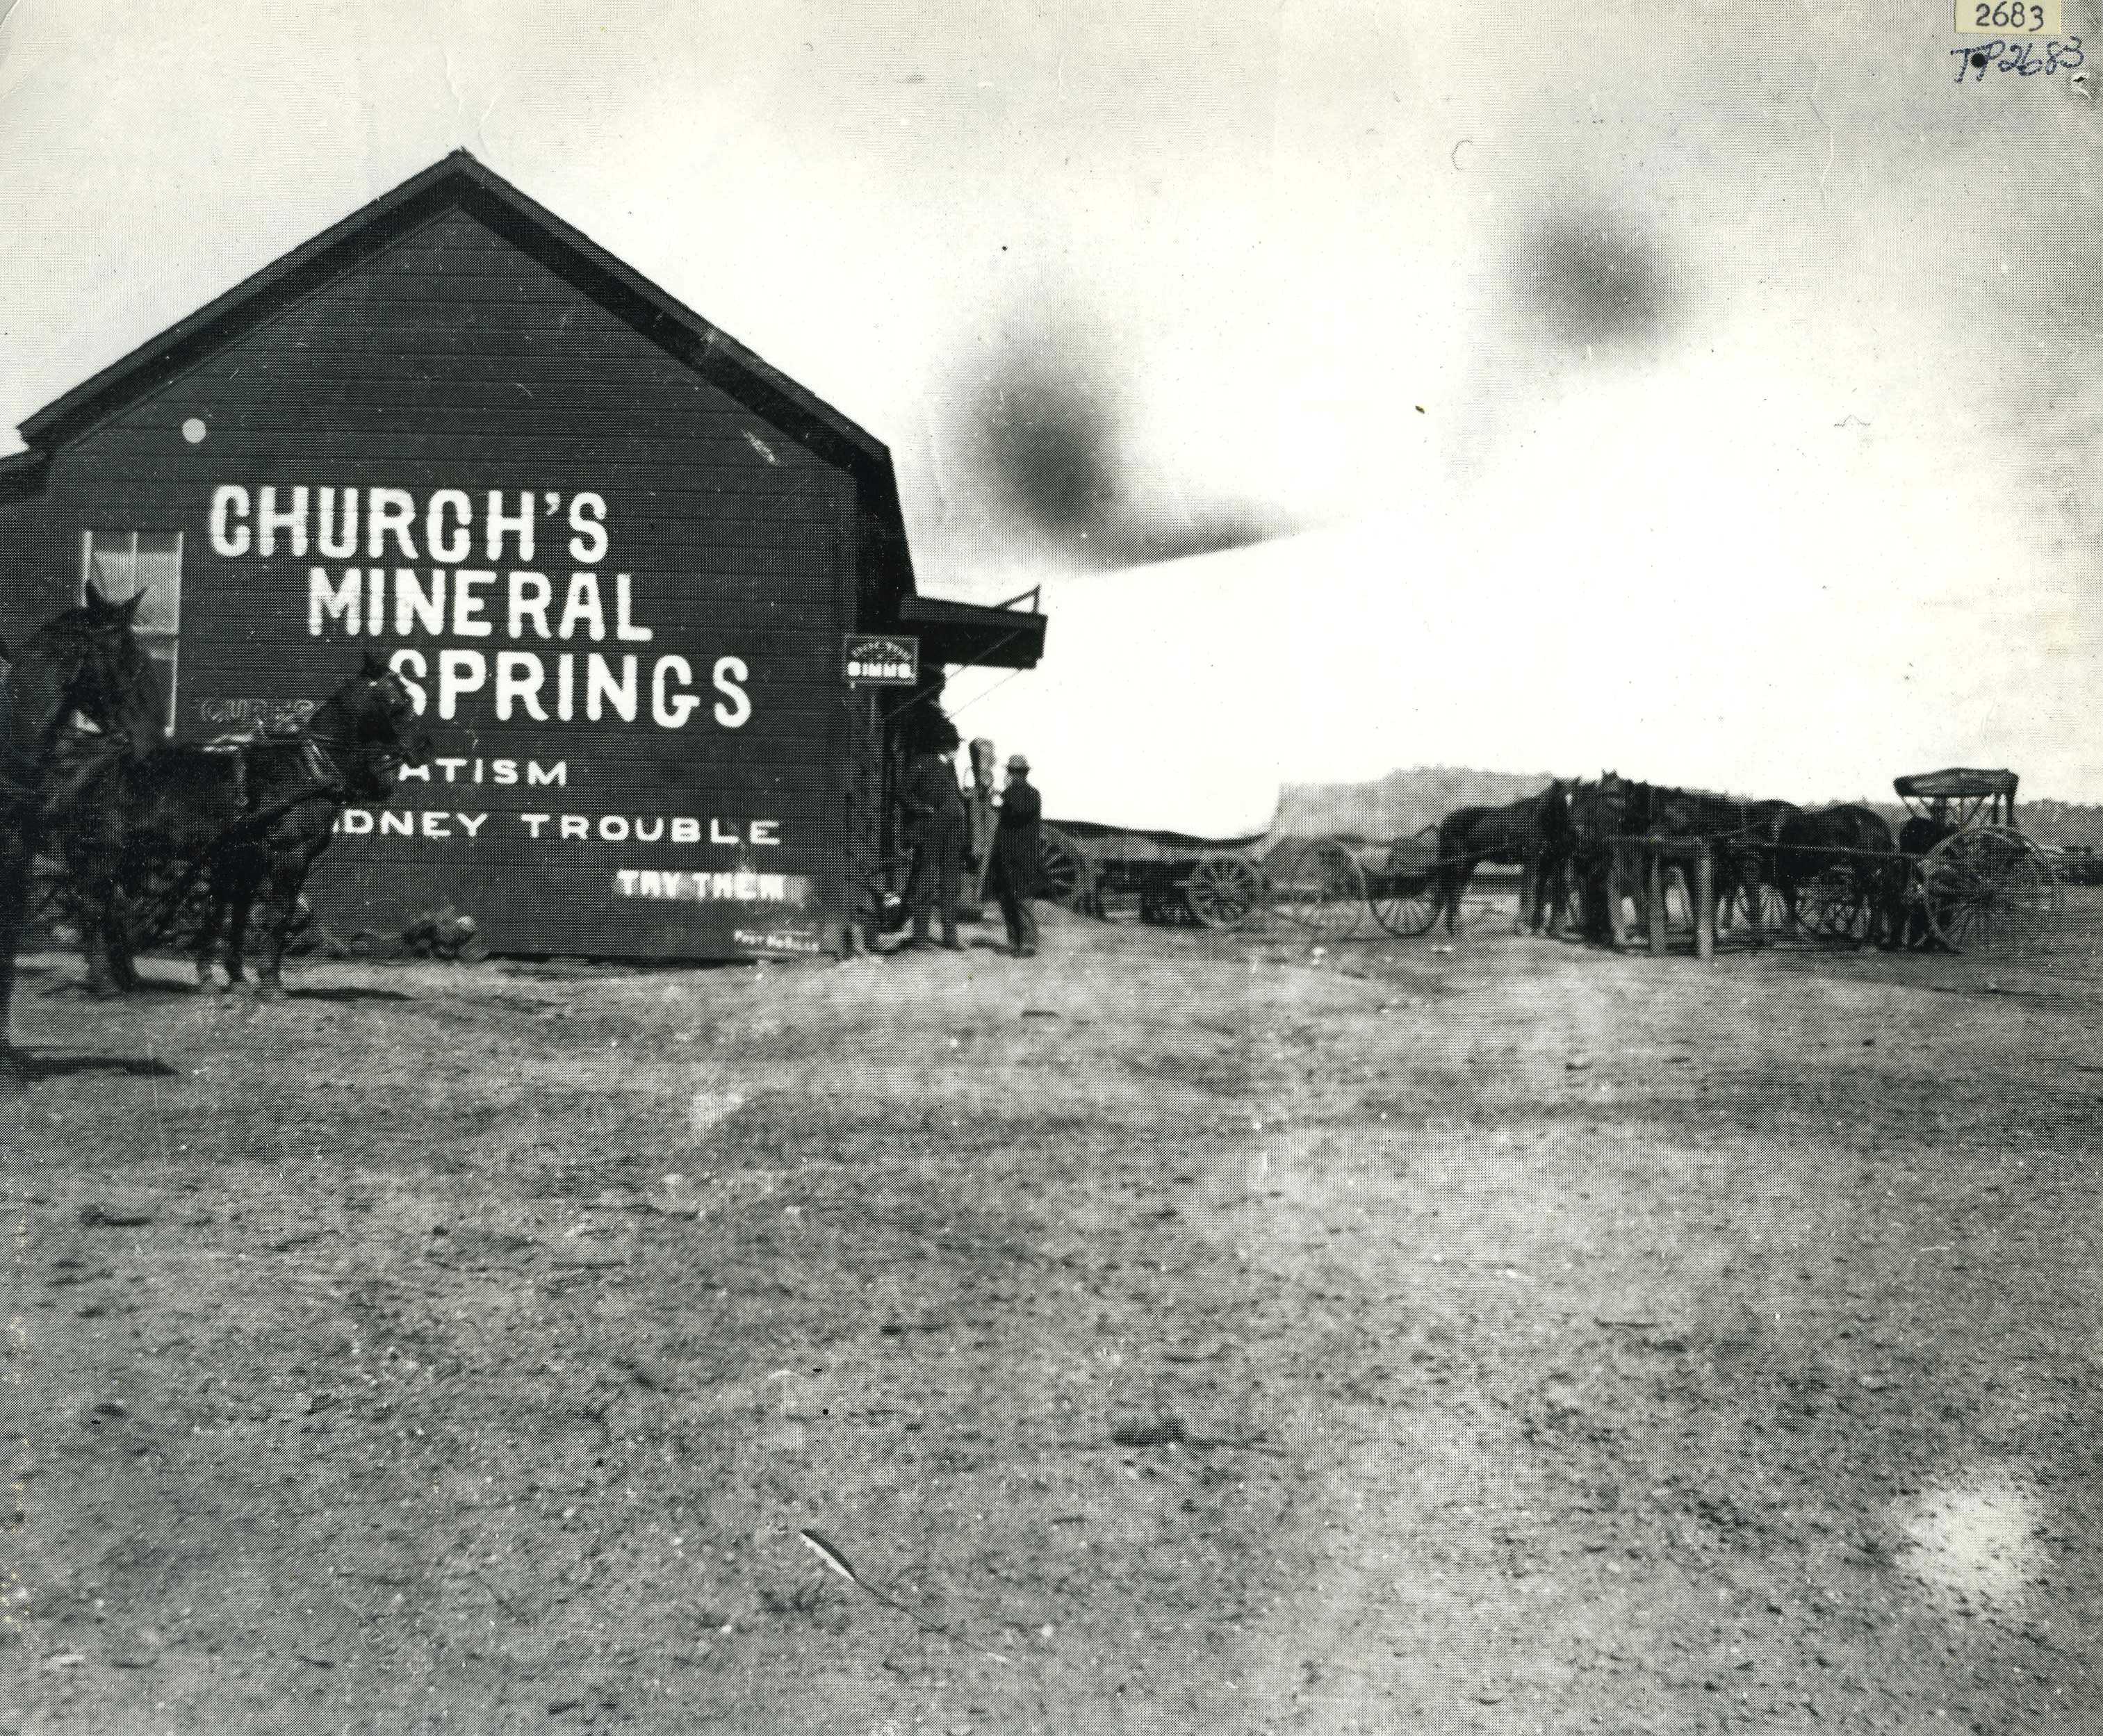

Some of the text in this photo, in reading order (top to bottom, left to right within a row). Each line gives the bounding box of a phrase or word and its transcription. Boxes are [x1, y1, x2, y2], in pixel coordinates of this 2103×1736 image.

[1975, 1, 2044, 32] 2683
[210, 484, 609, 564] CHURCH'S
[308, 566, 653, 641] MINERAL
[388, 648, 752, 728] SPRINGS
[519, 813, 780, 846] TROUBLE
